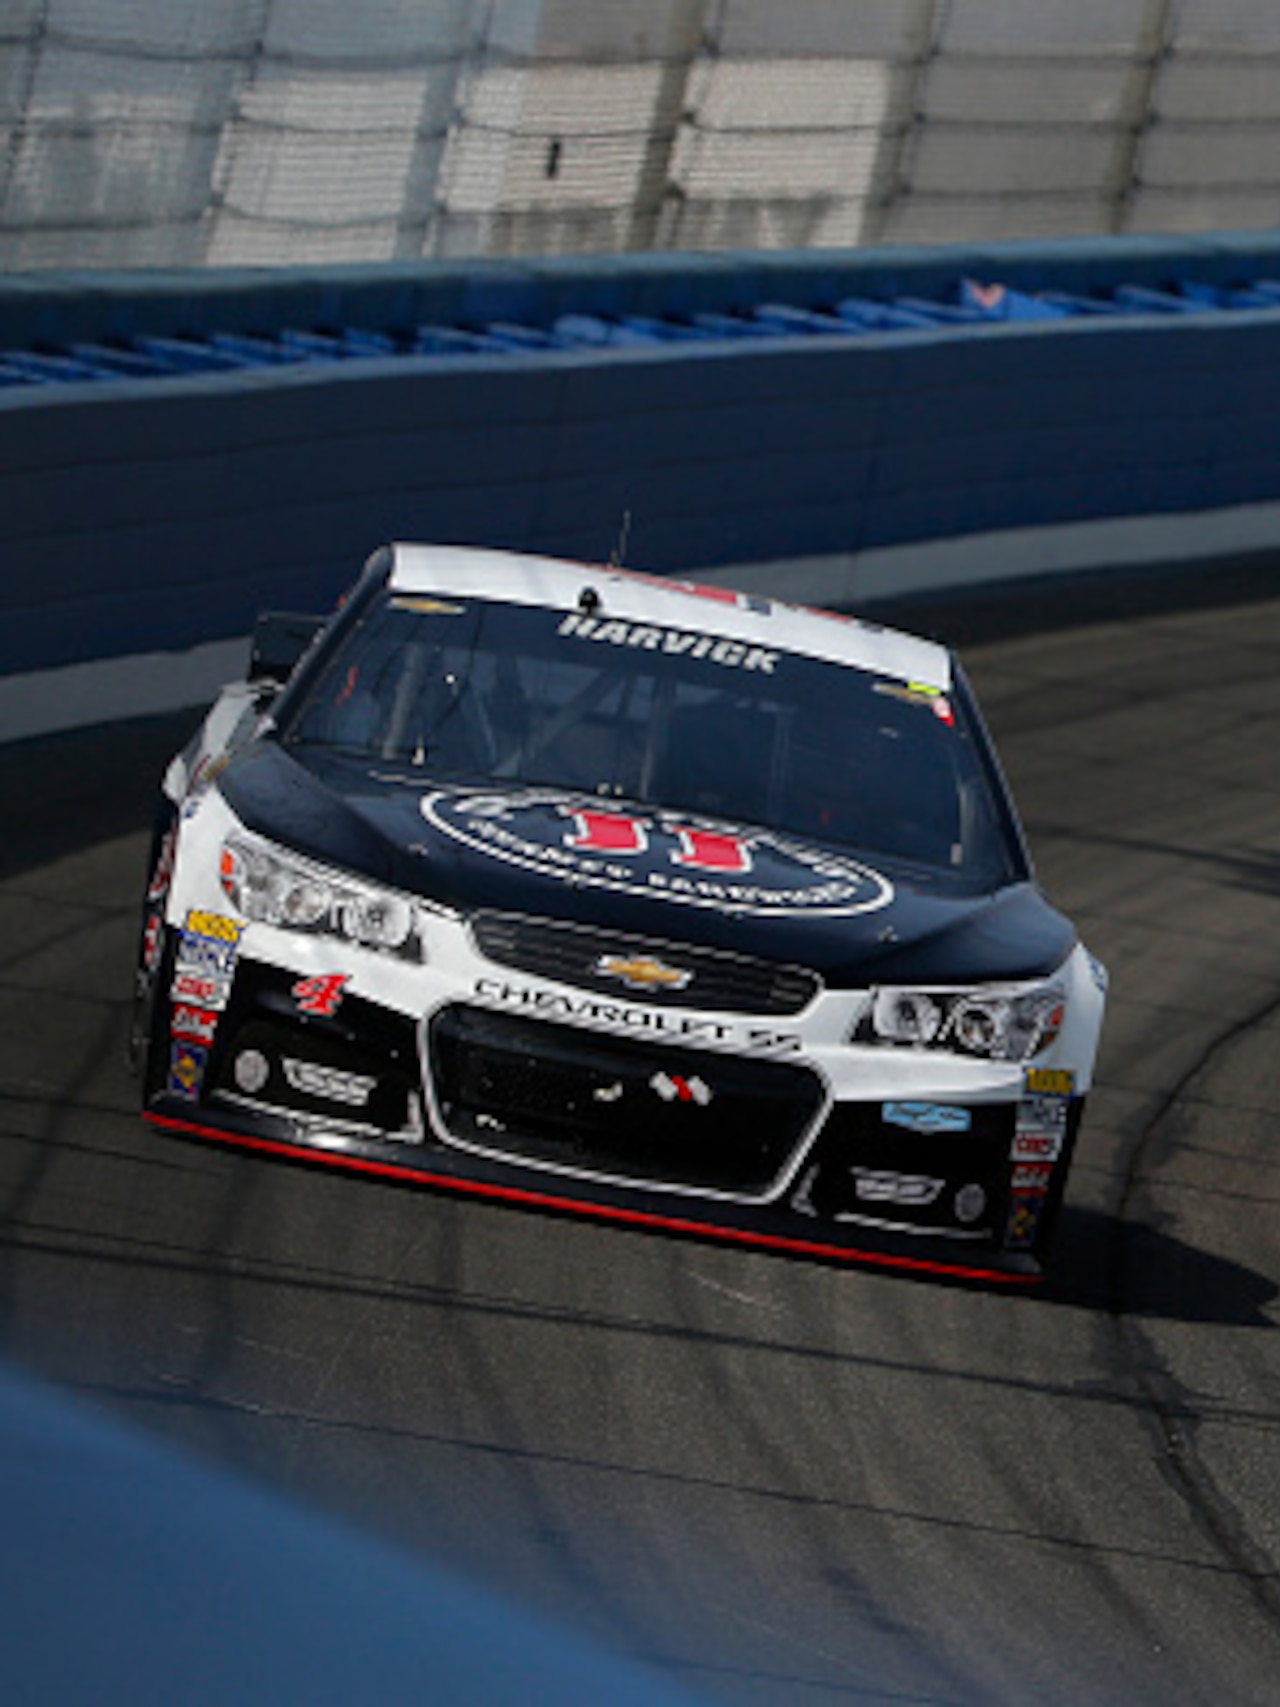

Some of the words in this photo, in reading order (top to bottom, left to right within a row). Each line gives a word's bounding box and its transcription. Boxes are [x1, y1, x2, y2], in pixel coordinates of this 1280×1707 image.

[556, 614, 782, 675] HARVICK
[291, 973, 352, 1017] 4
[474, 978, 733, 1040] CHEVROLET
[749, 1030, 802, 1052] SS
